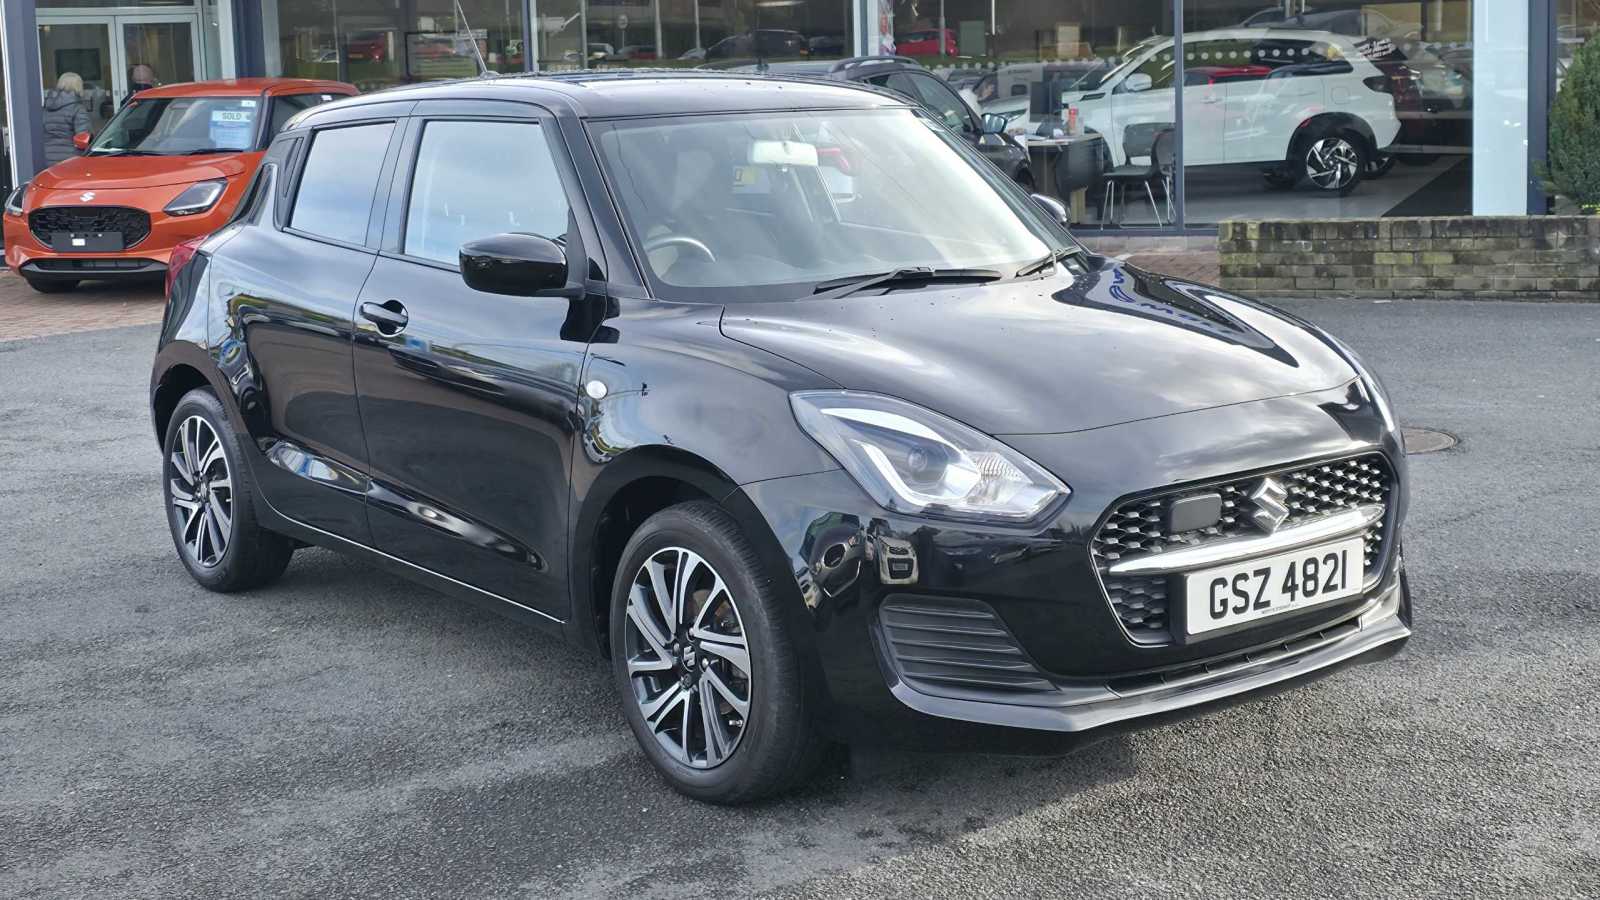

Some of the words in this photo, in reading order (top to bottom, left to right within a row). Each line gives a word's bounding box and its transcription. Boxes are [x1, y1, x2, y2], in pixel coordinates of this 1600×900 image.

[222, 112, 242, 120] SOLD
[1209, 566, 1272, 620] GSZ
[1281, 549, 1347, 602] 4821
